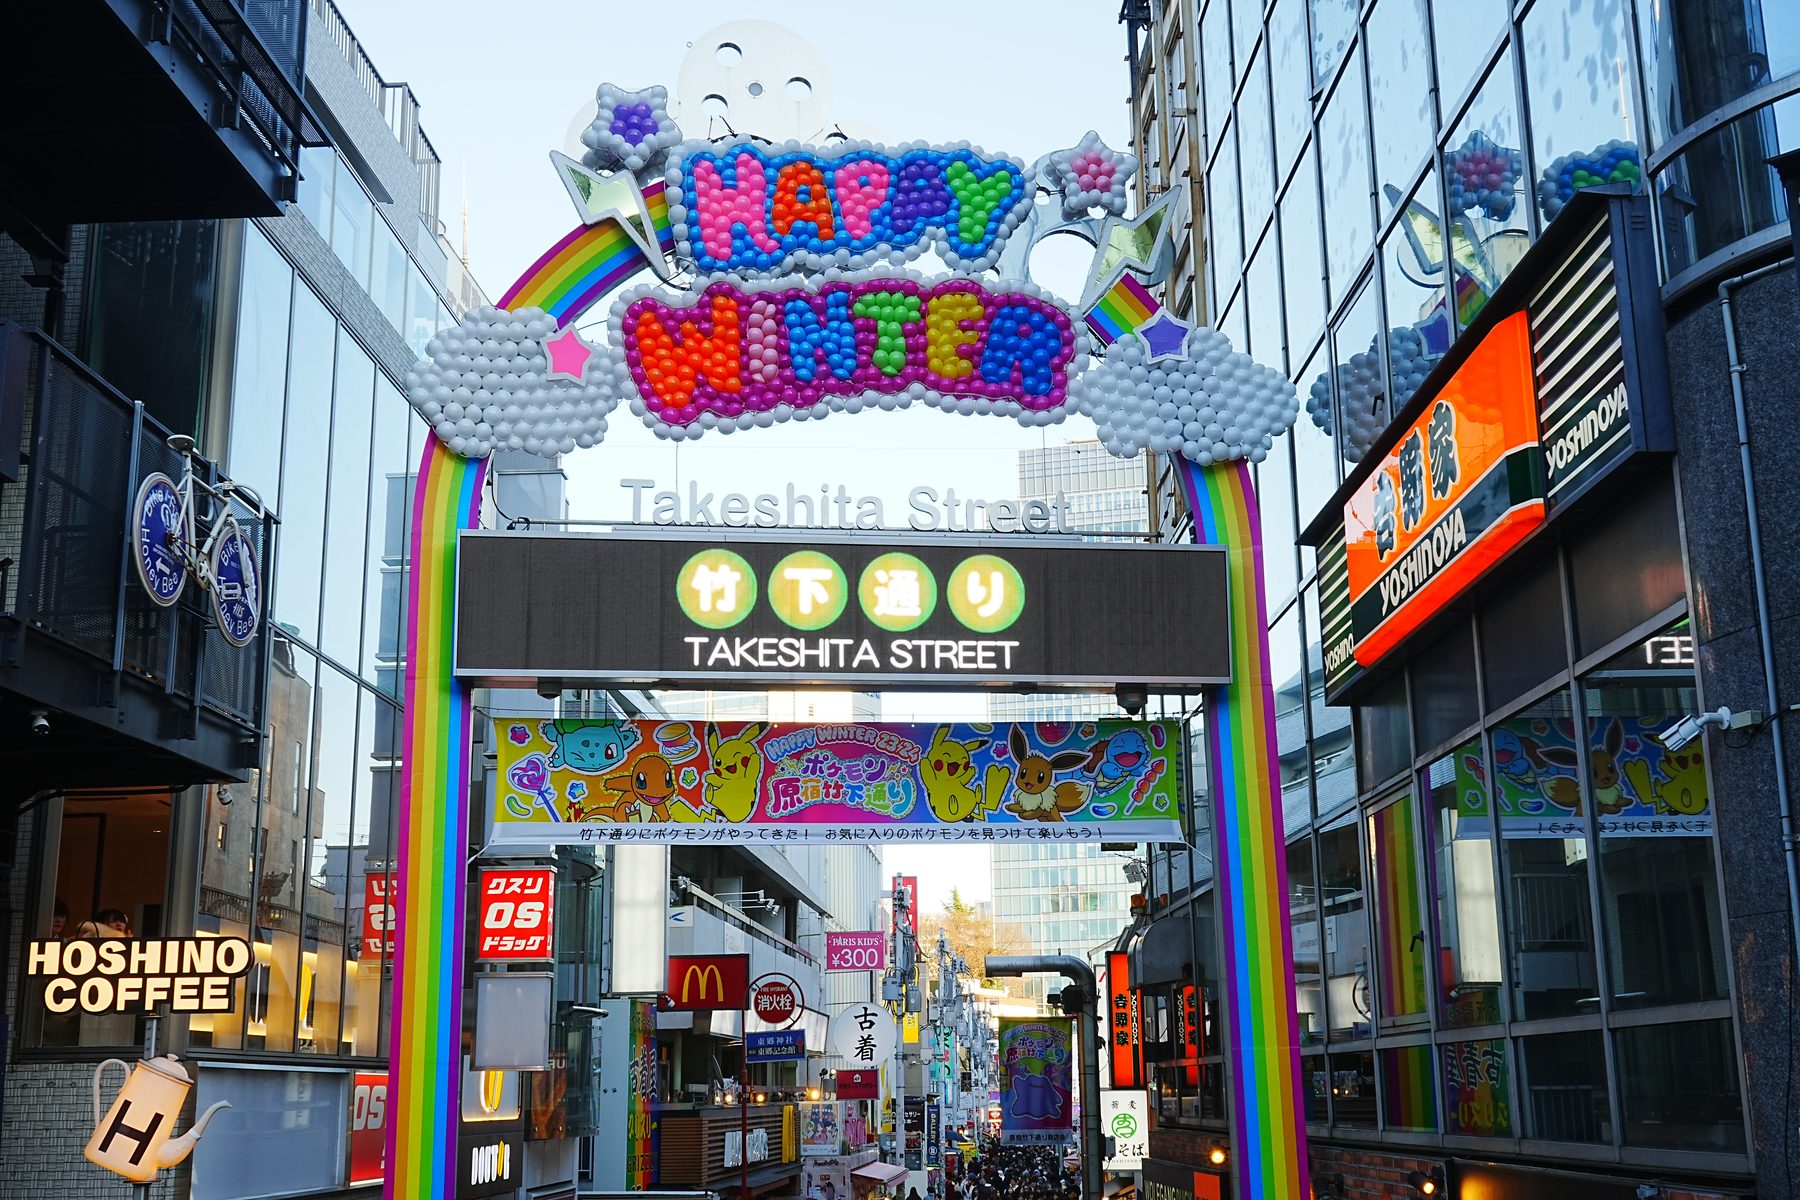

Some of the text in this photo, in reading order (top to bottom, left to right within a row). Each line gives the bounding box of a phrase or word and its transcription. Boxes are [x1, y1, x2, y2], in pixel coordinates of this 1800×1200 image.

[692, 152, 1012, 262] HAPPY
[636, 290, 1061, 408] WINTER
[1544, 382, 1630, 480] YOSHINOYA
[620, 478, 1075, 535] Takeshita Street
[1379, 508, 1467, 616] YOSHINOYA
[162, 572, 178, 593] Bee
[690, 563, 1004, 618] 竹下通り
[236, 616, 254, 635] Bee
[684, 636, 1020, 670] TAKESHITA STREET
[764, 728, 816, 763] HAPPY
[815, 725, 878, 746] WINTER
[800, 752, 888, 783] ポケモン
[769, 776, 914, 815] 原宿竹下通り
[579, 827, 1103, 841] 竹下通りにポケモンがやってきた！ お気に入りのポケモンを見つけて楽しもう！
[486, 877, 544, 895] クスリ
[484, 901, 545, 929] OS
[27, 938, 250, 976] HOSHINO
[482, 935, 545, 951] ドラッグ
[831, 948, 879, 968] ¥300
[832, 936, 879, 946] PARIS KID'S
[44, 976, 231, 1013] COFFEE
[757, 993, 793, 1012] 消火栓
[757, 1036, 793, 1047] 東郷神社
[853, 1006, 879, 1062] 古着
[98, 1098, 165, 1167] H
